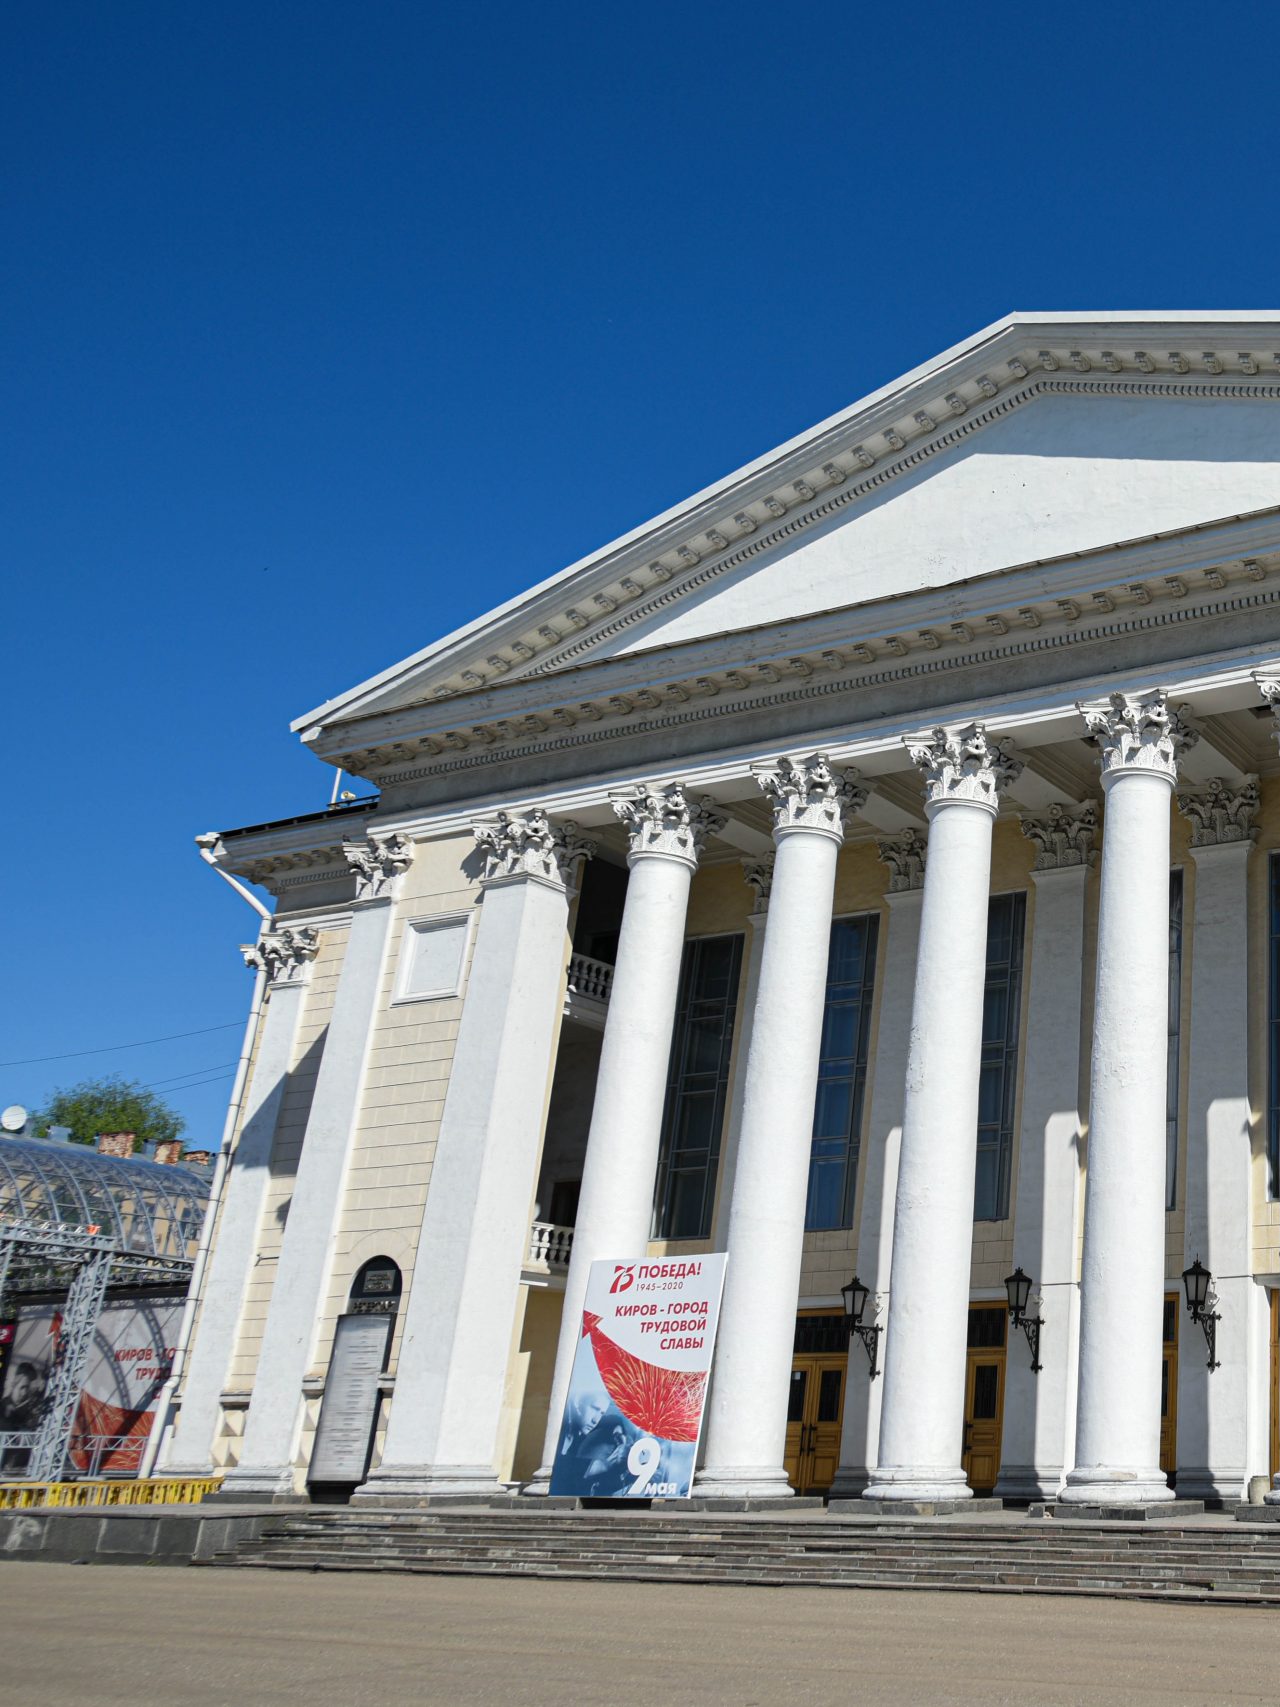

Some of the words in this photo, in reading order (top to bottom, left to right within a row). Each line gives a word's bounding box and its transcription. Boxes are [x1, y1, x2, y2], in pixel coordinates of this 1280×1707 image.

[638, 1262, 702, 1279] ПОБЕДА!
[615, 1305, 657, 1317] КИРОВ
[667, 1300, 708, 1316] ГОРОД
[640, 1316, 707, 1335] ТРУДОВОЙ
[660, 1337, 703, 1350] СЛАВЫ
[114, 1348, 153, 1363] КИРОВ
[628, 1438, 661, 1494] 9
[645, 1482, 677, 1495] мая
